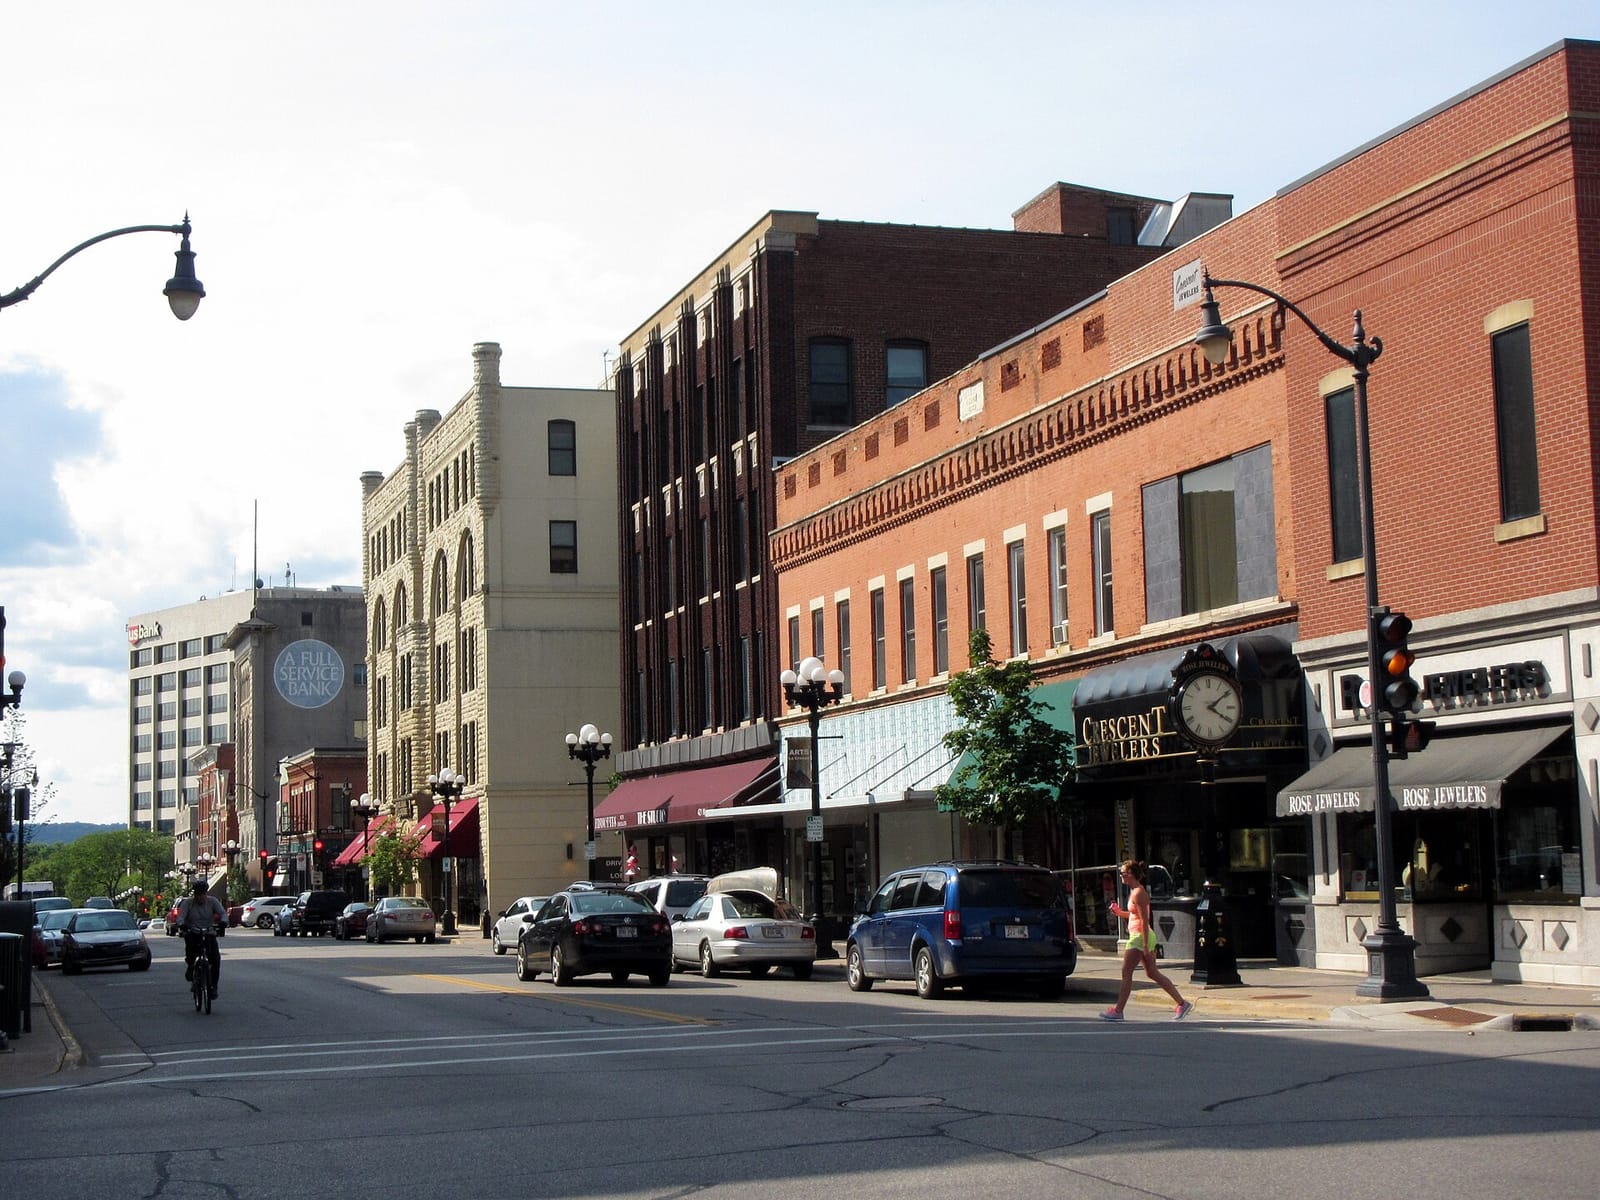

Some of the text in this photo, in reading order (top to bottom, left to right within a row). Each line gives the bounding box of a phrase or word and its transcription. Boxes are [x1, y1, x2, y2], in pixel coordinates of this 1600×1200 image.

[283, 651, 335, 666] A FULL
[280, 666, 339, 681] SERVICE
[288, 681, 332, 697] BANK
[1087, 737, 1161, 765] JEWELERS
[1288, 791, 1361, 813] ROSE JEWELERS
[1402, 785, 1488, 807] ROSE JEWELERS
